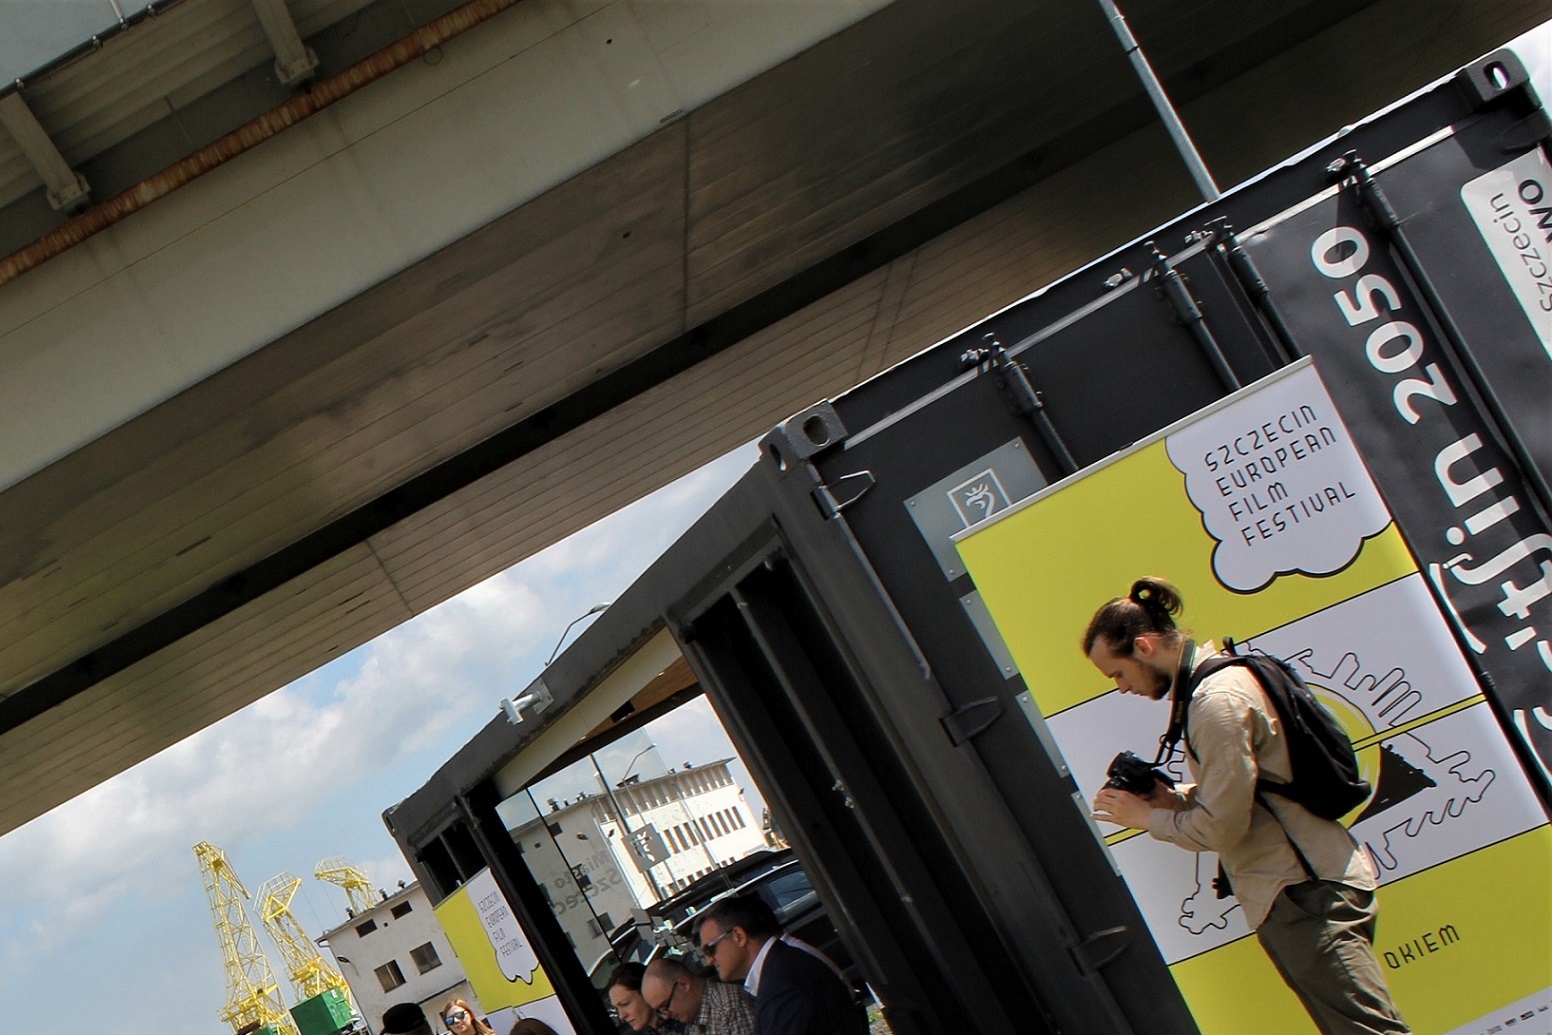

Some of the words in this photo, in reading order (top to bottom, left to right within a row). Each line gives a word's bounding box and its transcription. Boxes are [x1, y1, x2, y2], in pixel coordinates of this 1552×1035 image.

[1311, 226, 1458, 426] 2050
[1204, 405, 1317, 472] SZCZECIN
[1215, 426, 1337, 497] EUROPEAN
[1228, 481, 1288, 522] FILM
[1241, 481, 1356, 547] FESTIVAL
[1383, 923, 1461, 970] OKIEM
